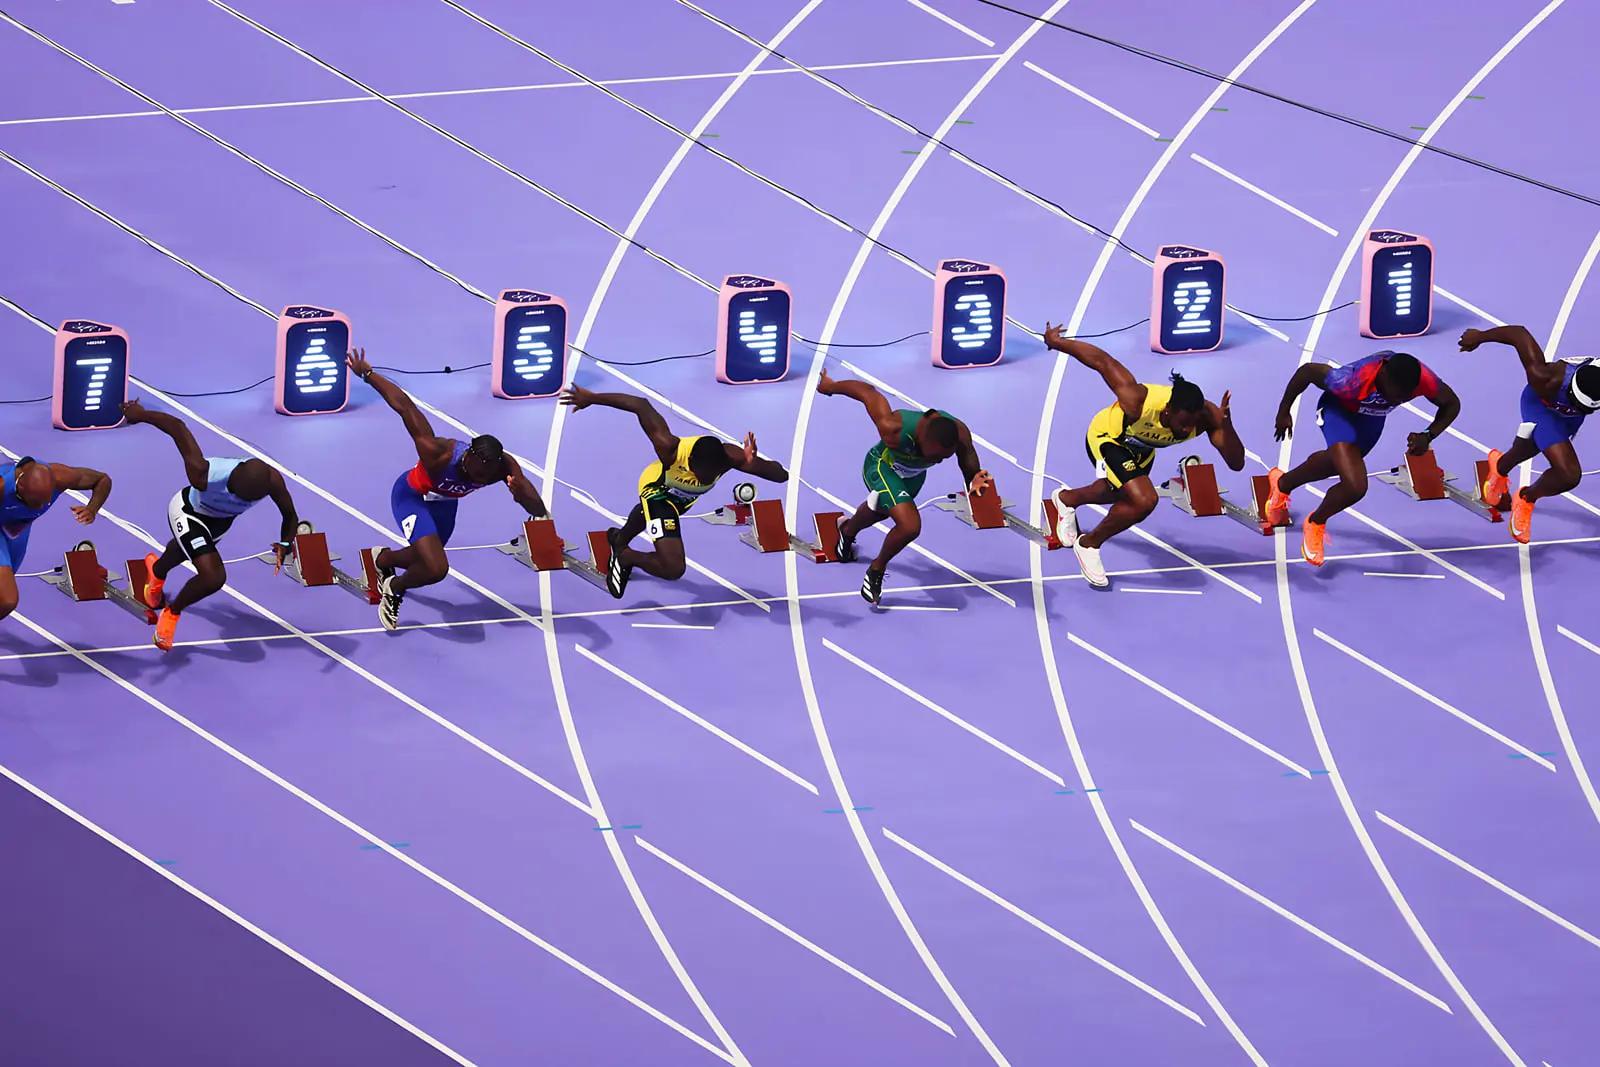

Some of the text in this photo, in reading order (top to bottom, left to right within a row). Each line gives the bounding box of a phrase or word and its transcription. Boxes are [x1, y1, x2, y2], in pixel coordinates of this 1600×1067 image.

[1172, 281, 1212, 335] 2
[1388, 262, 1413, 315] 1
[739, 311, 778, 364] 4
[951, 294, 993, 348] 3
[295, 338, 337, 393] 6
[513, 325, 553, 380] 5
[76, 358, 112, 409] 7
[176, 521, 184, 533] 8
[650, 523, 658, 535] 6
